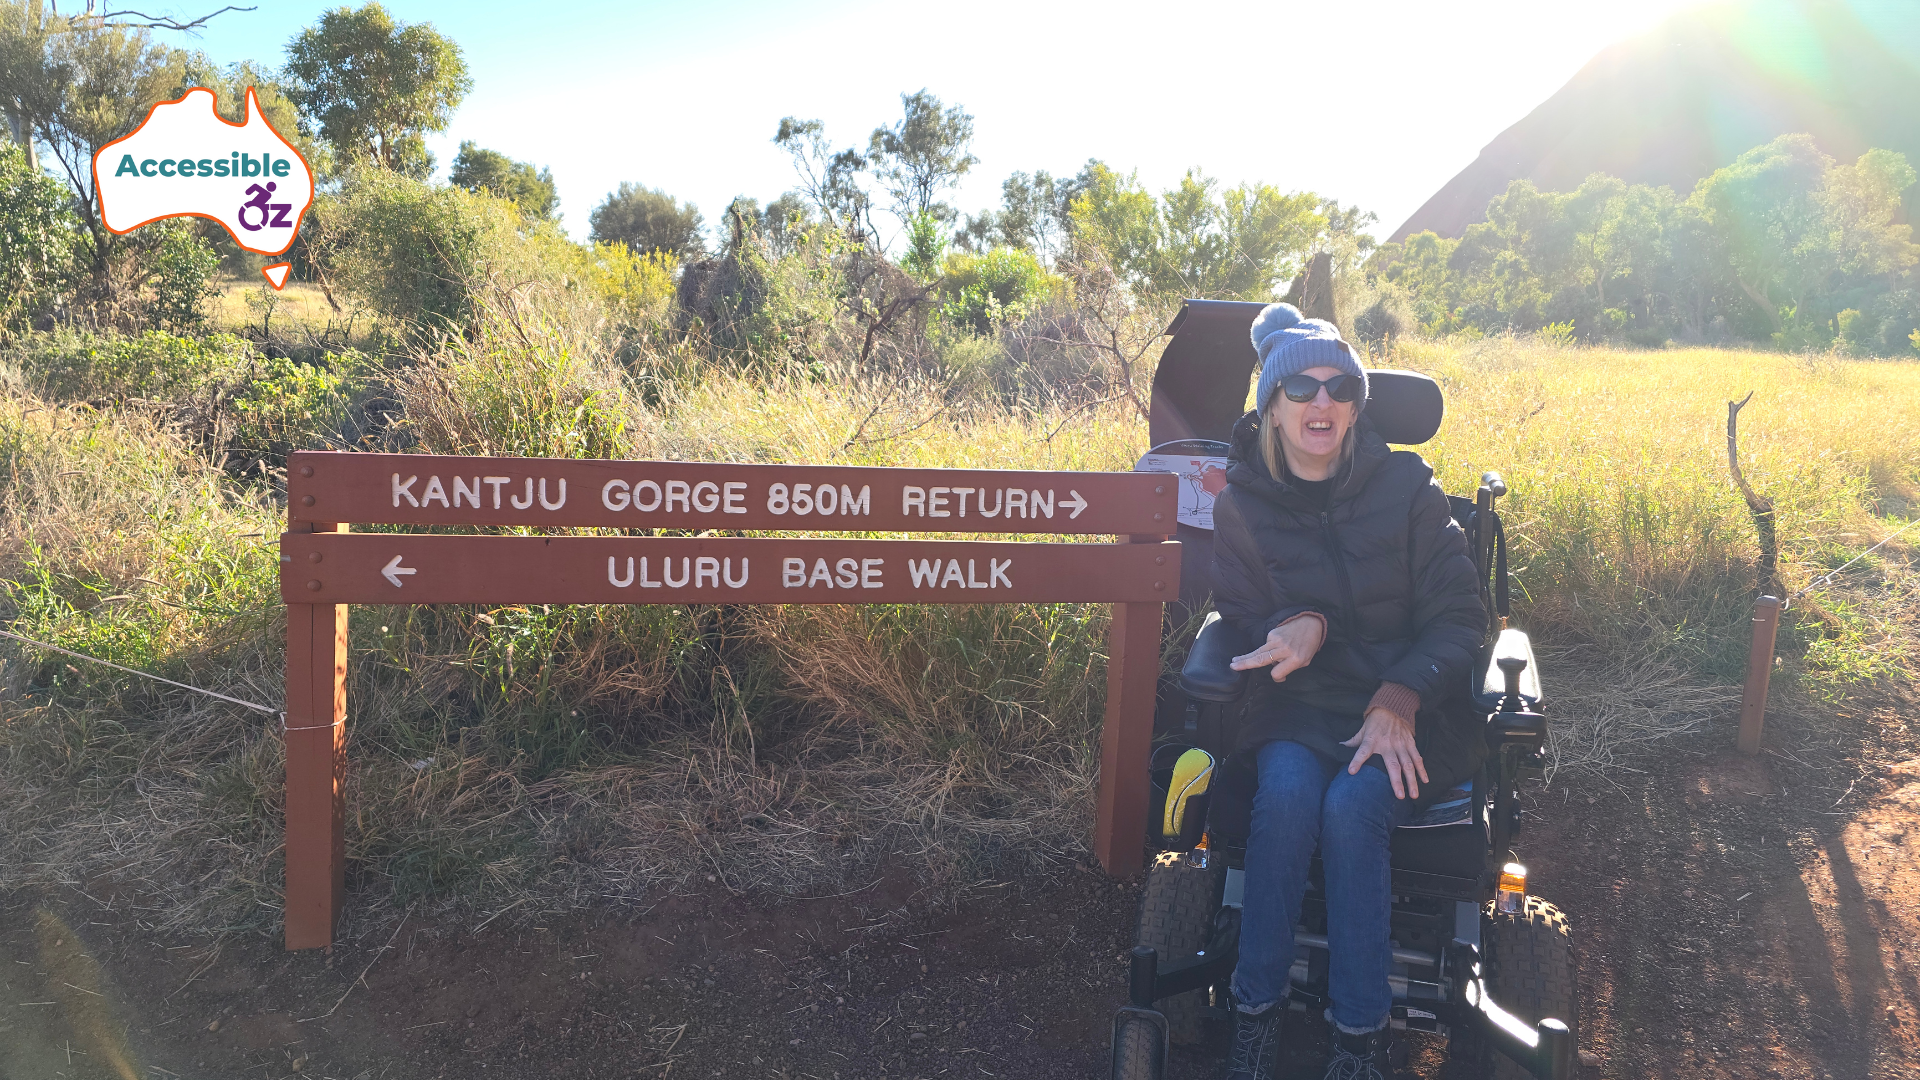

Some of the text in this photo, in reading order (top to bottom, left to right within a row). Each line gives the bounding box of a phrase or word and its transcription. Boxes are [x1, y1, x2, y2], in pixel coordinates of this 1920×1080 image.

[391, 473, 1054, 519] KANTJU GORGE 850M RETURN
[607, 555, 1013, 589] ULURU BASE WALK
